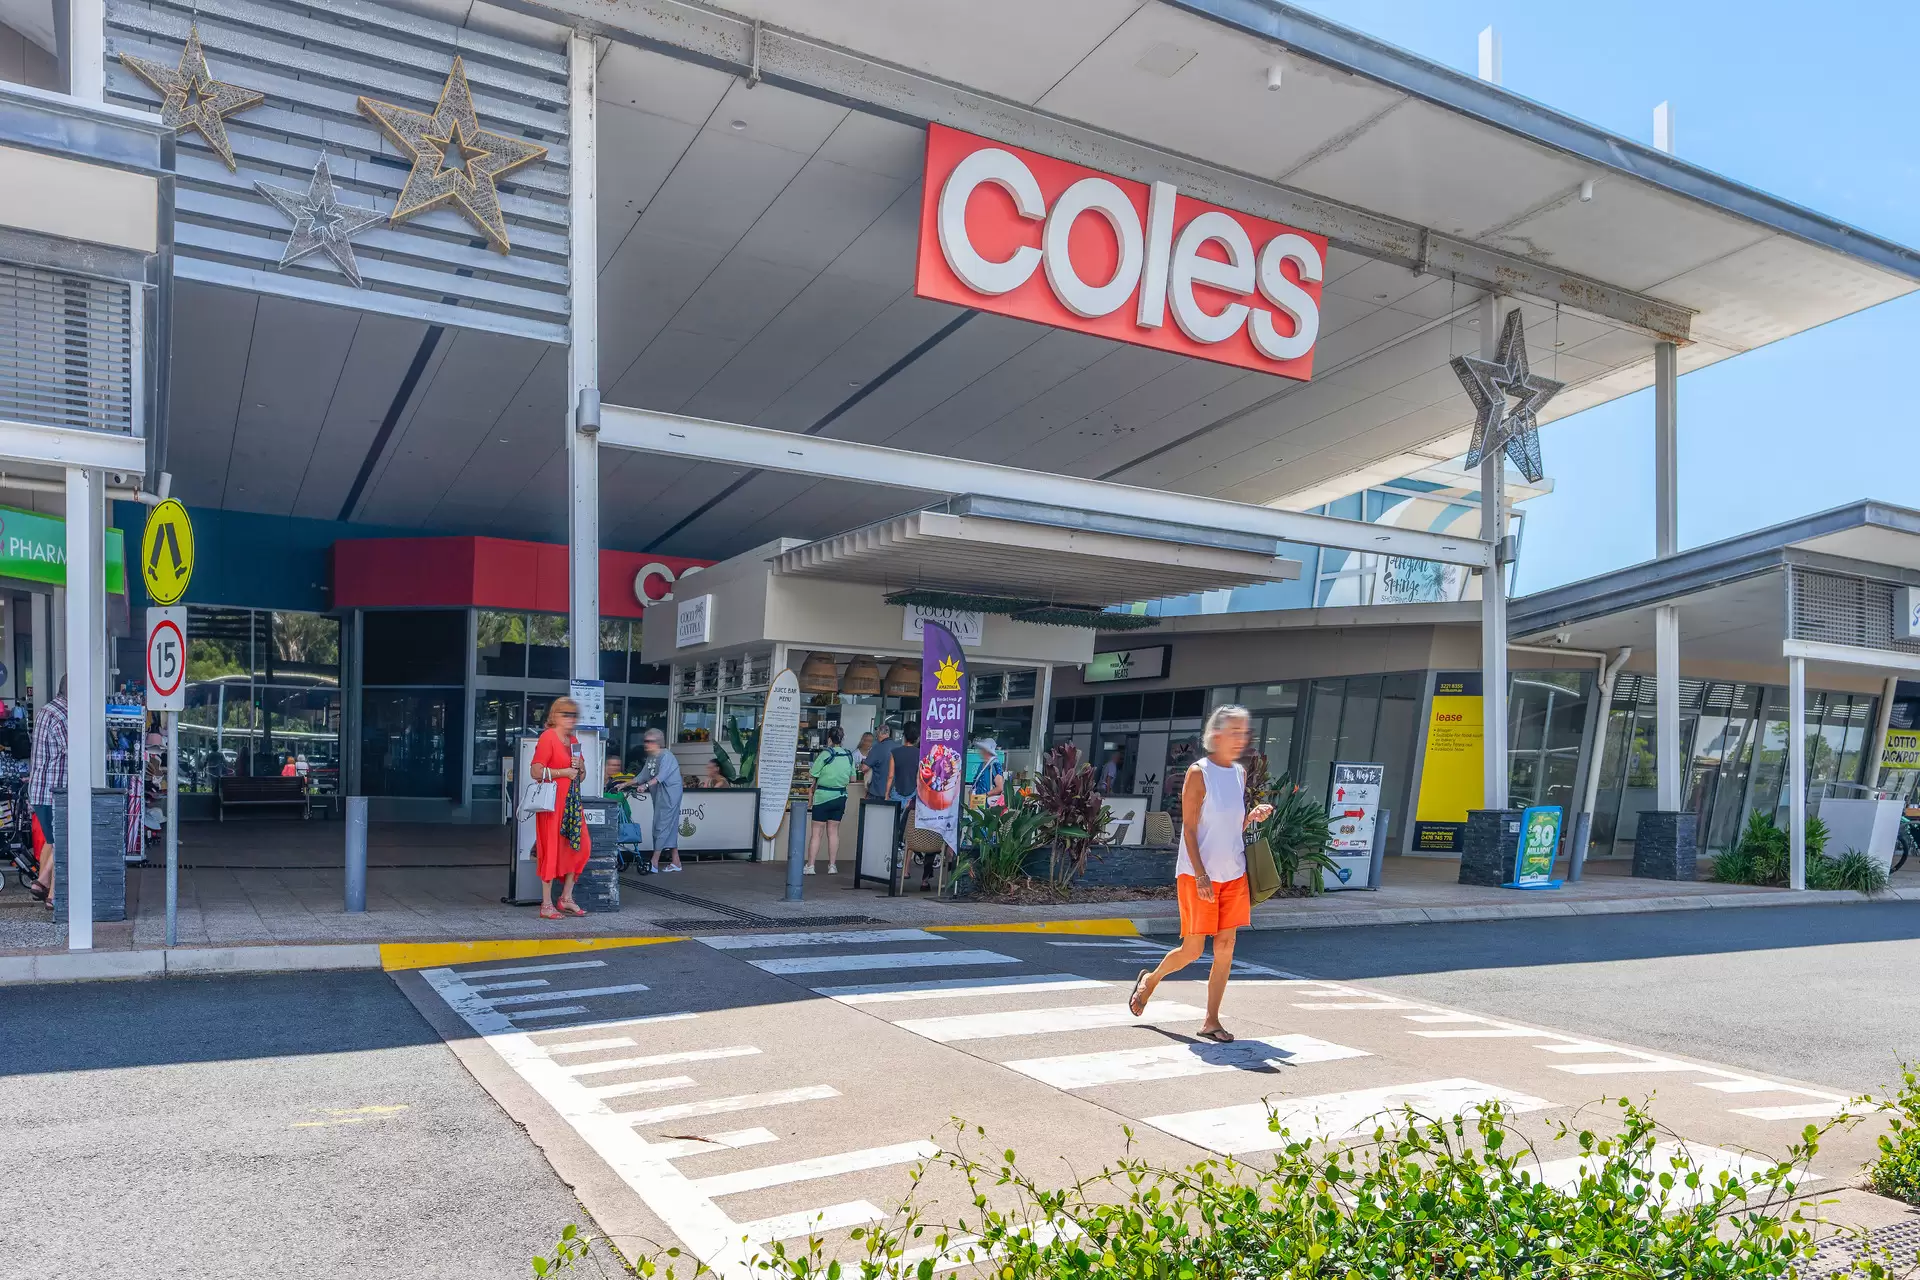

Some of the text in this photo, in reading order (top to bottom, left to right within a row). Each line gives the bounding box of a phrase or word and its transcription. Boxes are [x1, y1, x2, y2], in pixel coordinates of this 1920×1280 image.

[937, 147, 1322, 361] coles
[1384, 571, 1420, 602] Springs
[916, 605, 952, 618] COCO
[914, 617, 969, 634] CTINA
[156, 641, 176, 678] 15
[926, 697, 962, 724] Açaí
[1436, 712, 1463, 722] lease
[1888, 735, 1917, 748] LOTTO
[1528, 824, 1555, 847] $30
[1527, 846, 1552, 856] MILLION
